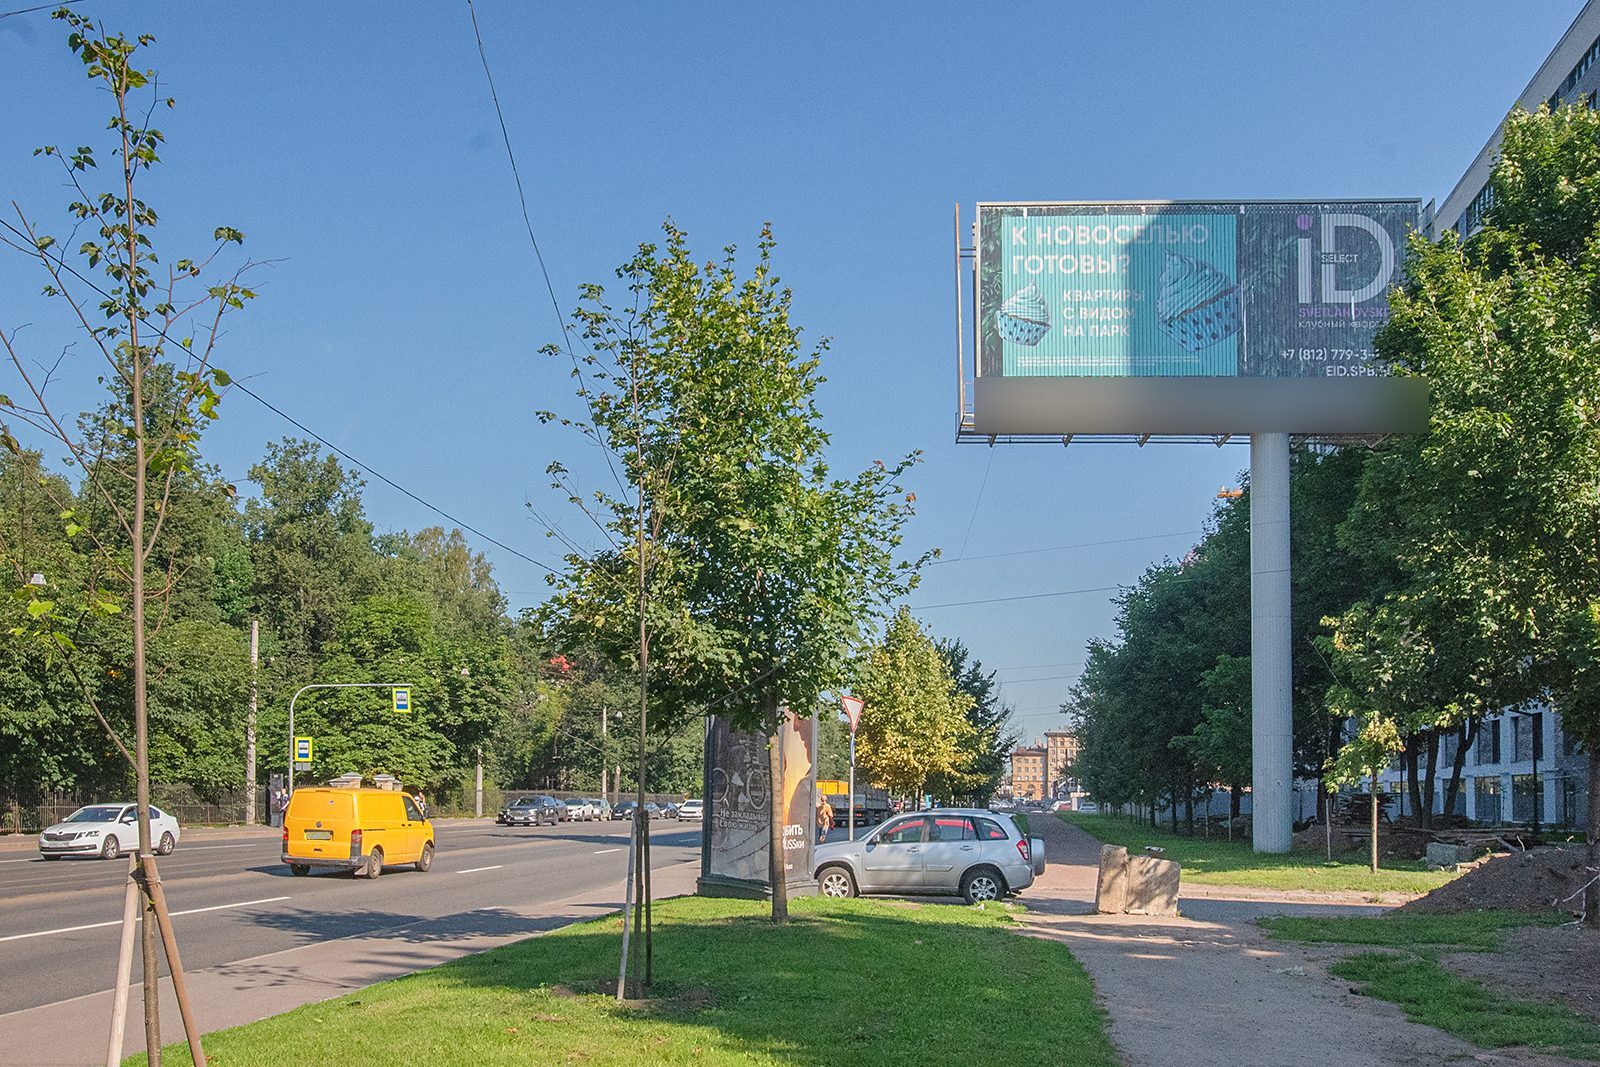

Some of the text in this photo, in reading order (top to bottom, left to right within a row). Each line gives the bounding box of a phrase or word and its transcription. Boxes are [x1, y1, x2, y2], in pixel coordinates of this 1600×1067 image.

[1012, 224, 1209, 246] К НОВОСЕЛЬЮ
[1012, 254, 1131, 275] ГОТОВЫ?
[1321, 254, 1359, 264] SELECT
[1063, 289, 1144, 303] КВАРТИРЫ
[1063, 307, 1135, 321] С ВИДОМ
[1063, 324, 1130, 337] НА ПАРК
[1298, 320, 1346, 330] клубный
[1282, 349, 1295, 360] +7
[1299, 347, 1327, 361] (812)
[720, 808, 730, 818] Не
